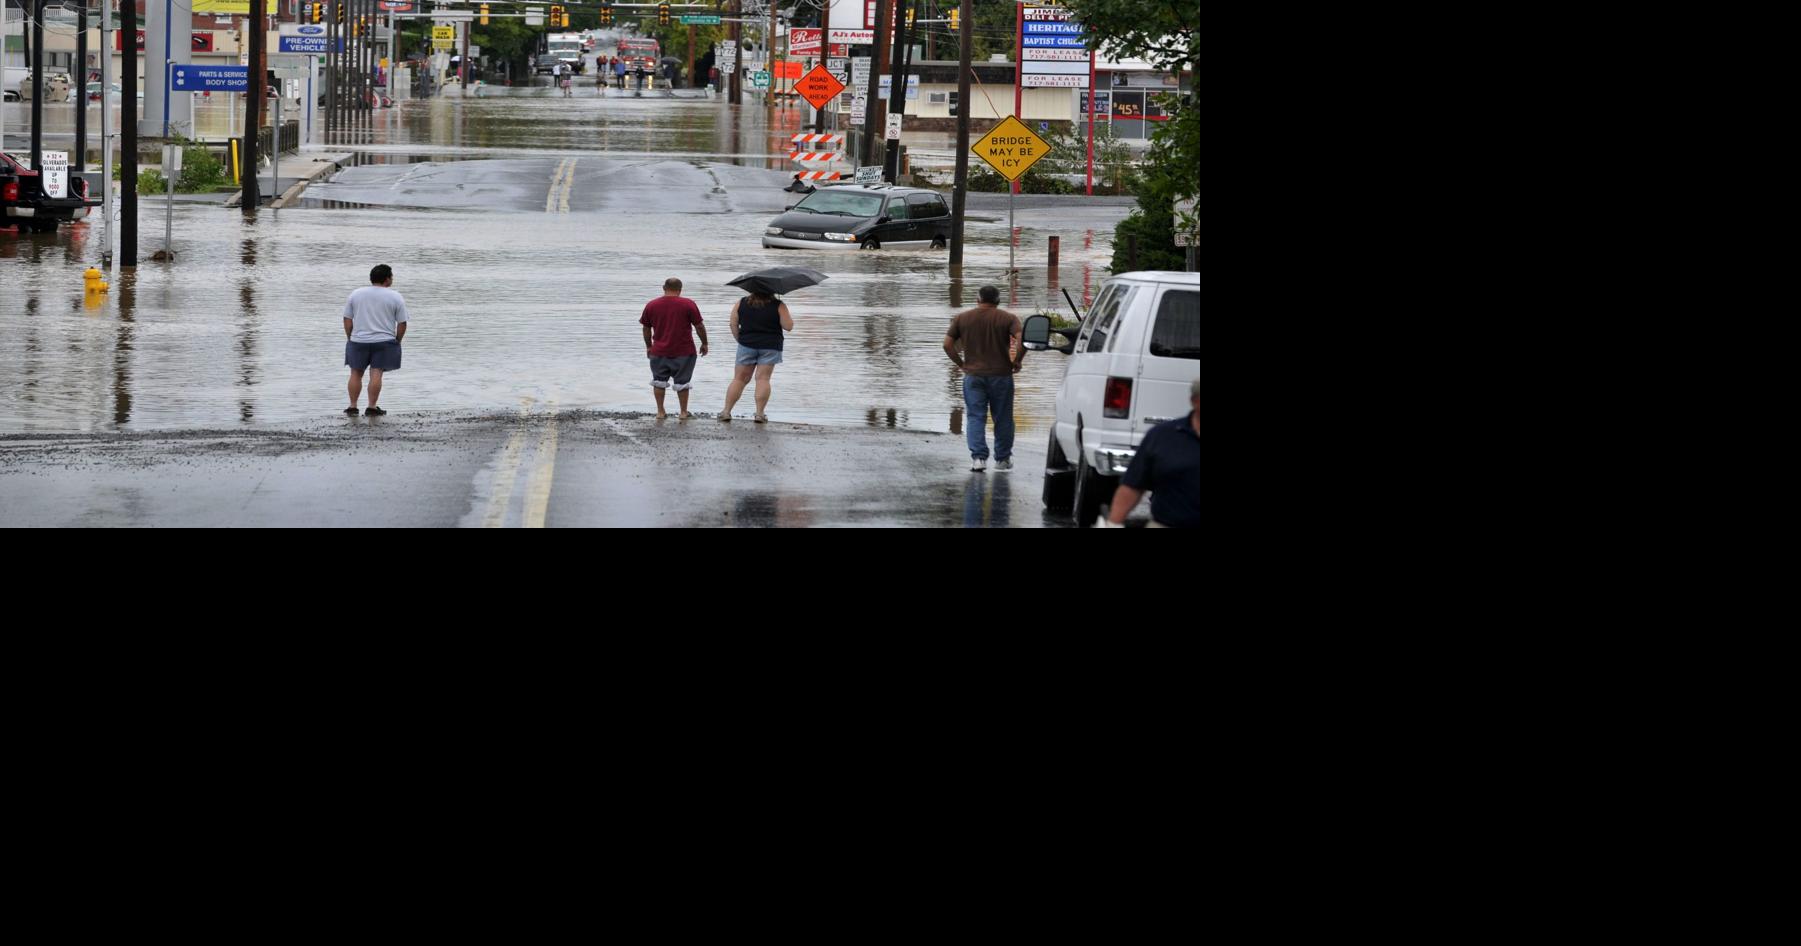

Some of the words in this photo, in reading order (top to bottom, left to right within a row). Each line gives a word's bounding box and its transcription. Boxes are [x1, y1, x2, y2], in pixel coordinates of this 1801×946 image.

[1025, 37, 1055, 45] BAPTIST
[290, 44, 328, 52] VEHICLE
[829, 60, 844, 68] JCT
[198, 70, 217, 78] PARTS
[223, 70, 248, 78] SERVICE
[991, 136, 1032, 145] BRIDGE
[989, 147, 1013, 156] MAY
[1019, 147, 1033, 156] BE
[1002, 159, 1020, 167] ICY
